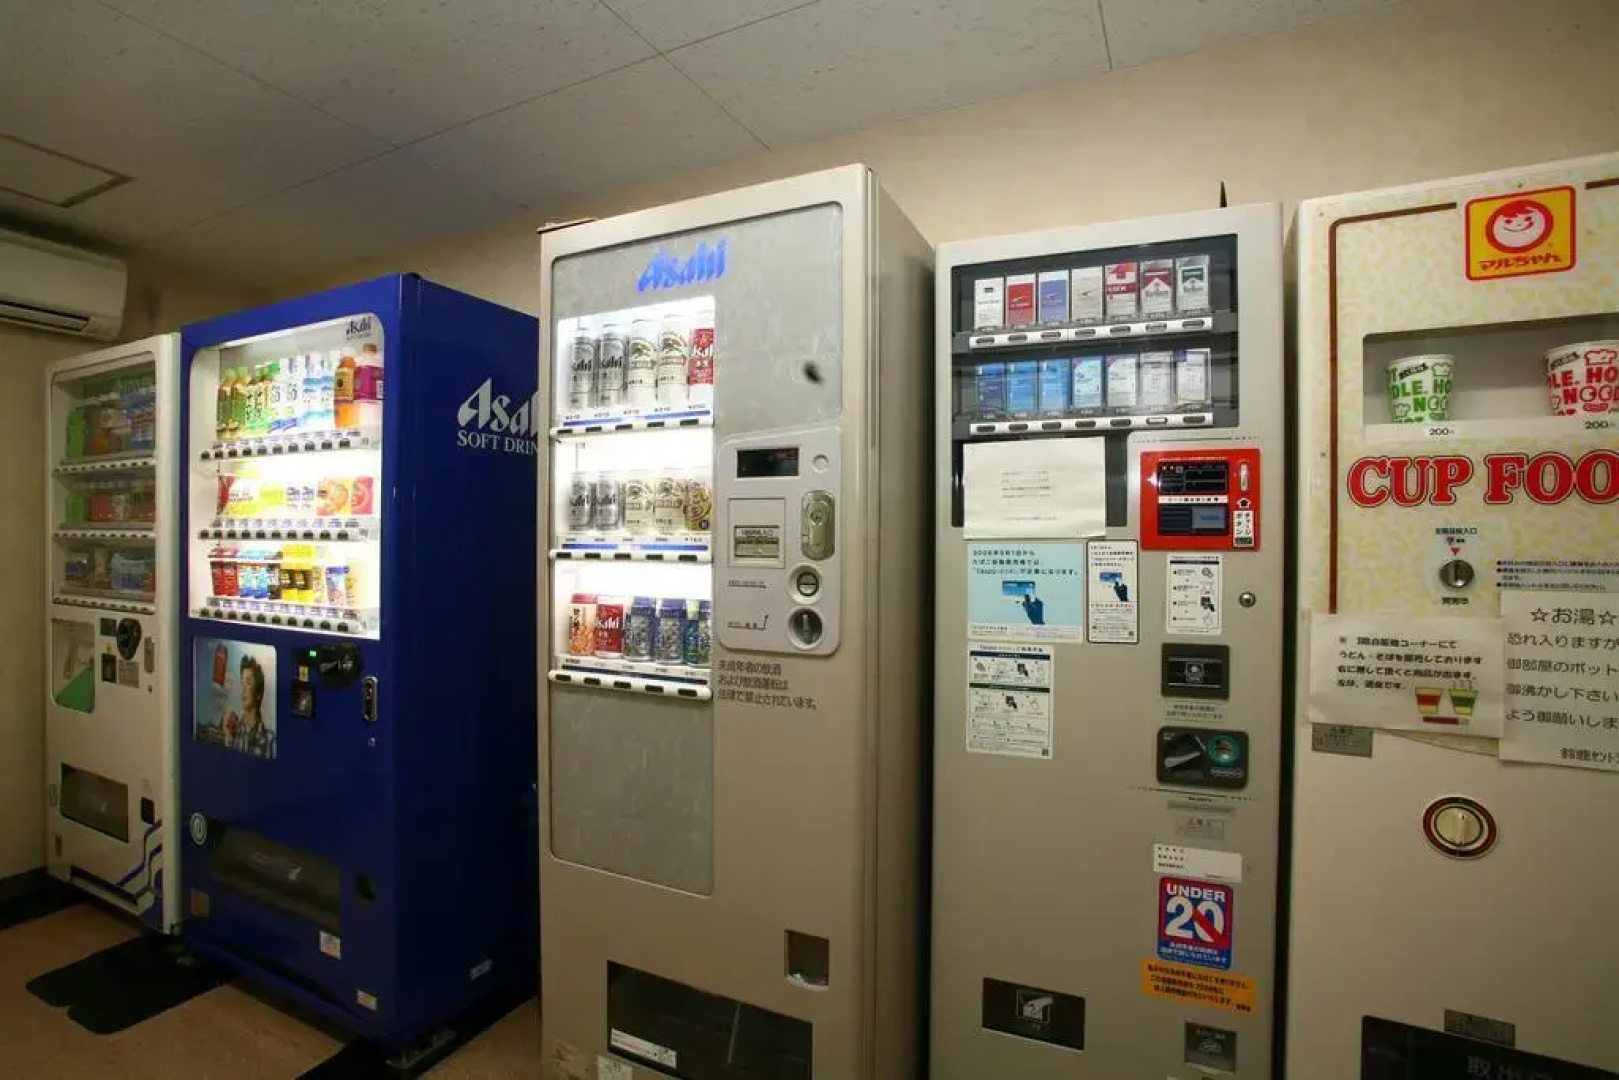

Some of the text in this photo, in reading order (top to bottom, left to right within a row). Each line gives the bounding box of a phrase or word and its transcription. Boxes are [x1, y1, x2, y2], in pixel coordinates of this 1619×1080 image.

[637, 238, 728, 292] Asahi
[1480, 253, 1562, 271] マルちゃん
[457, 429, 499, 450] SOFT
[1347, 449, 1619, 508] CUP FOO
[1506, 631, 1619, 651] 恐れ入りますが
[1166, 883, 1226, 902] UNDER
[1164, 896, 1225, 943] 20
